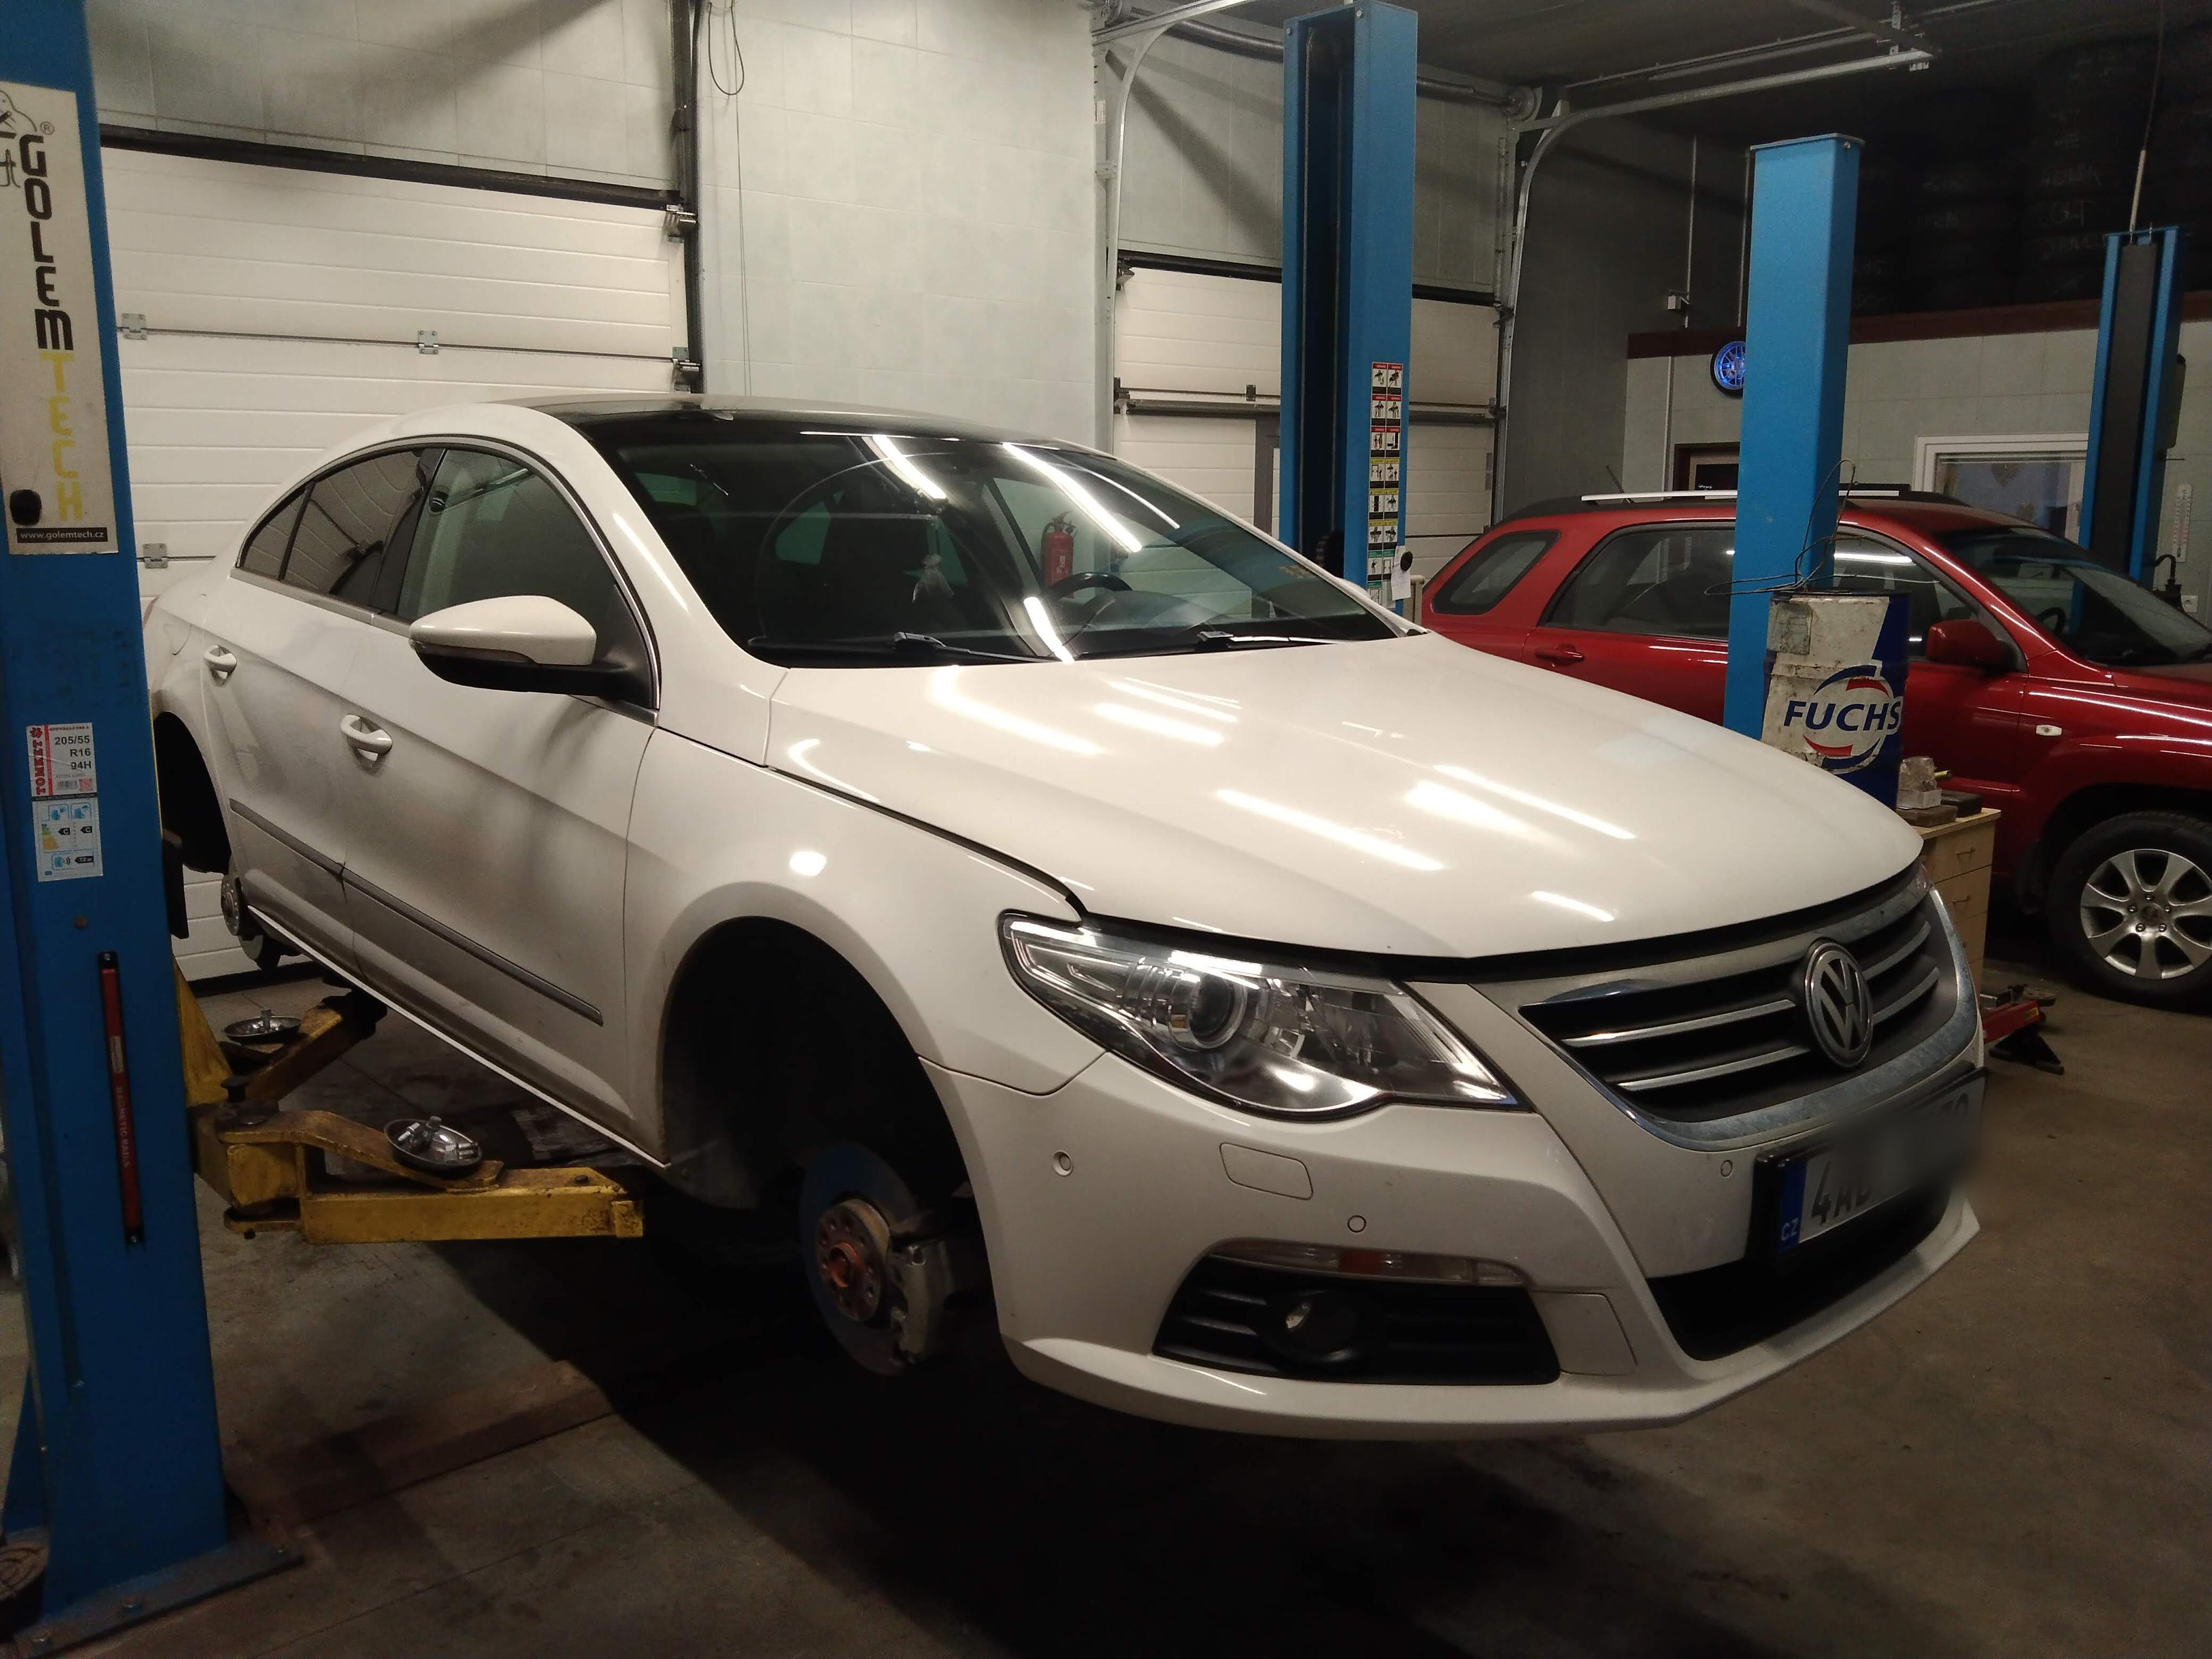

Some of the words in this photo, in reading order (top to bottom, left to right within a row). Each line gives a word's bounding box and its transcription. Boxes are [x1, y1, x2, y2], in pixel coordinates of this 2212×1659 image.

[20, 530, 105, 540] www.golemtech.cz
[1783, 700, 1901, 731] FUCHS
[55, 735, 90, 745] 205/55
[70, 748, 91, 757] R16
[71, 761, 92, 770] 94H
[1781, 1218, 1799, 1241] CZ
